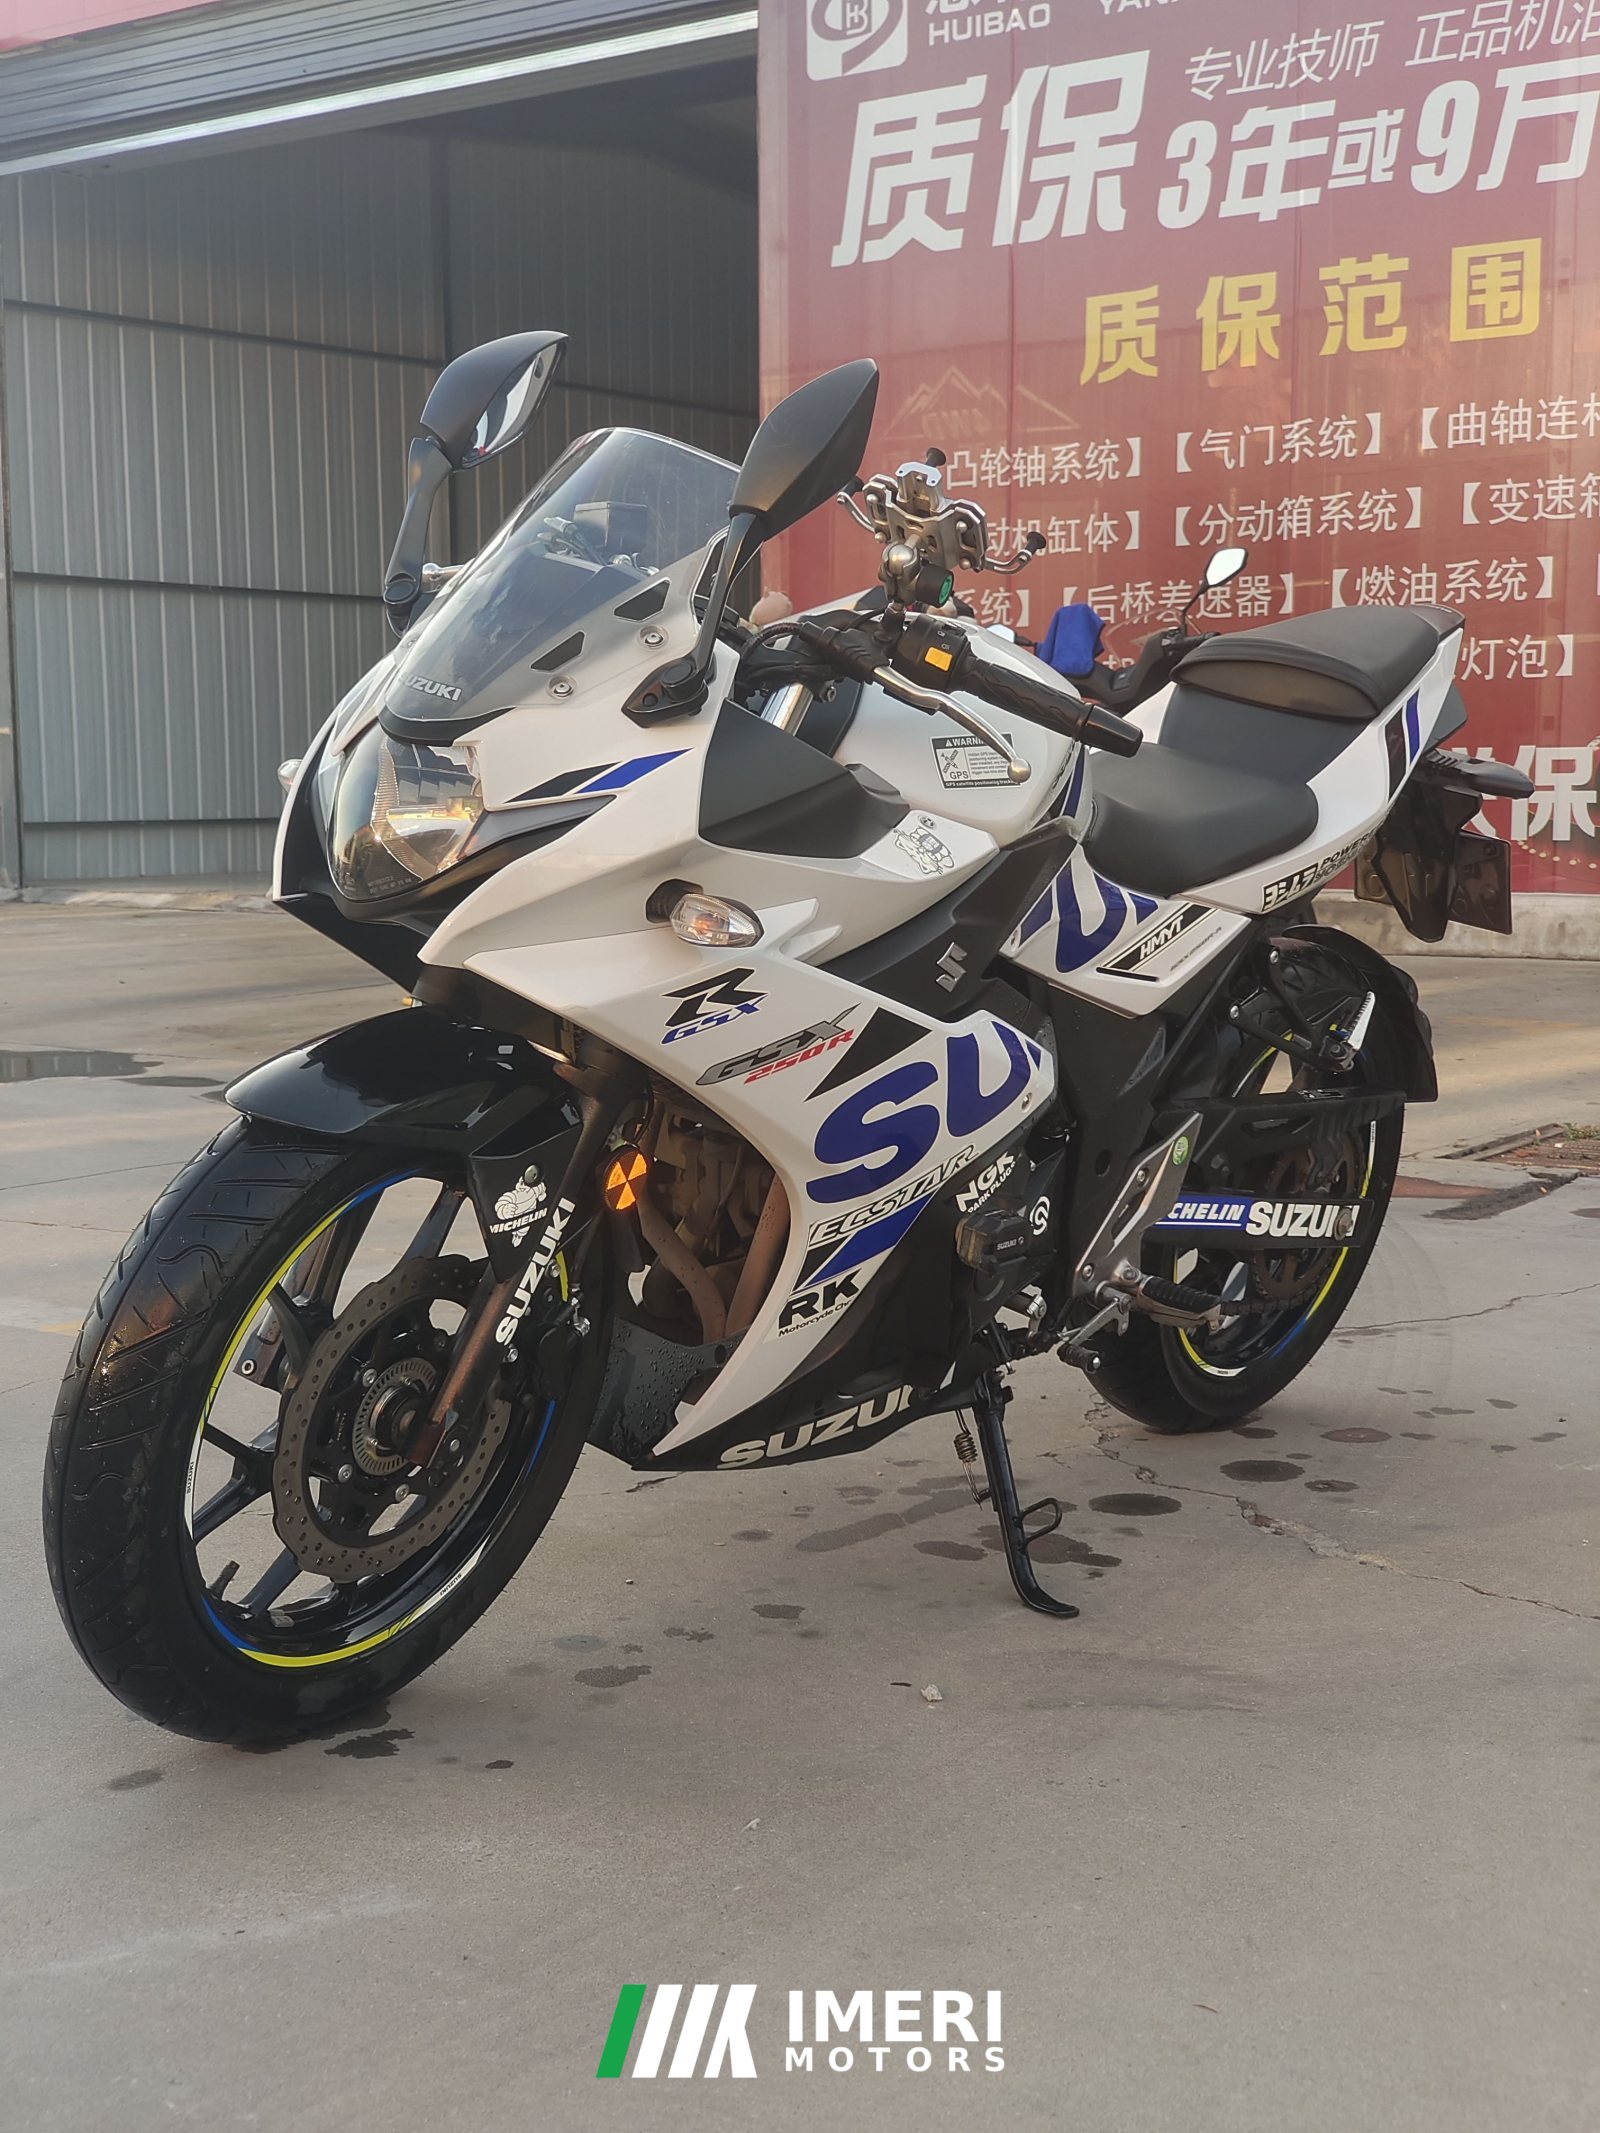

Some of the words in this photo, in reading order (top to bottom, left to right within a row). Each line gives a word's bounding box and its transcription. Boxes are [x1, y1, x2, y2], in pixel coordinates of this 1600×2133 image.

[928, 3, 1050, 46] HUIBAO
[1185, 20, 1384, 101] 专业技师
[402, 674, 462, 701] UZUKI
[950, 771, 969, 780] GPS
[1140, 915, 1184, 960] HMYT
[661, 994, 769, 1044] GSX
[696, 1002, 862, 1085] GSX
[806, 1020, 1041, 1203] SU
[809, 1144, 979, 1245] ECSTAR
[956, 1151, 1014, 1213] NGK
[495, 1197, 575, 1346] SUZUKI
[778, 1267, 862, 1330] RK
[779, 1309, 834, 1337] Motorcycle
